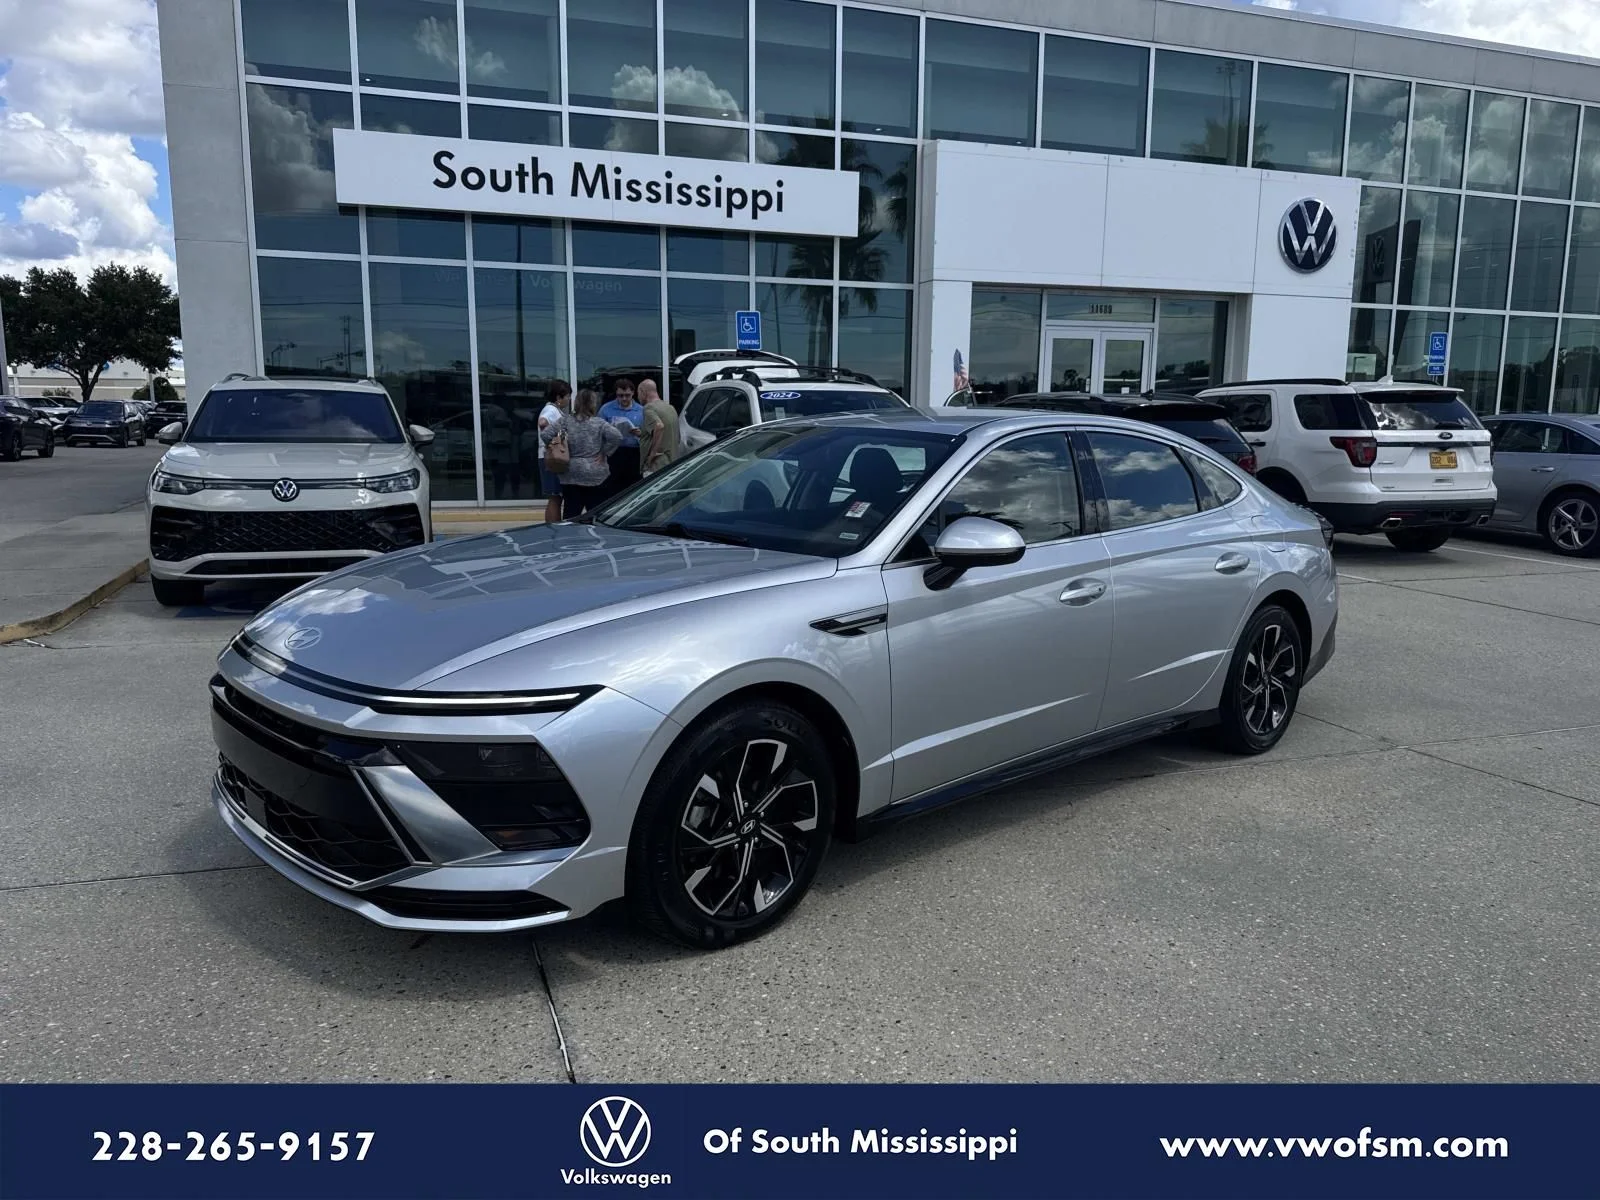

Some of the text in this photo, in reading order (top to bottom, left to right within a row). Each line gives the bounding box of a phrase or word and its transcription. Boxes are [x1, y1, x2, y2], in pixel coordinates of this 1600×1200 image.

[433, 151, 784, 220] South Mississippi
[768, 391, 793, 399] 2024
